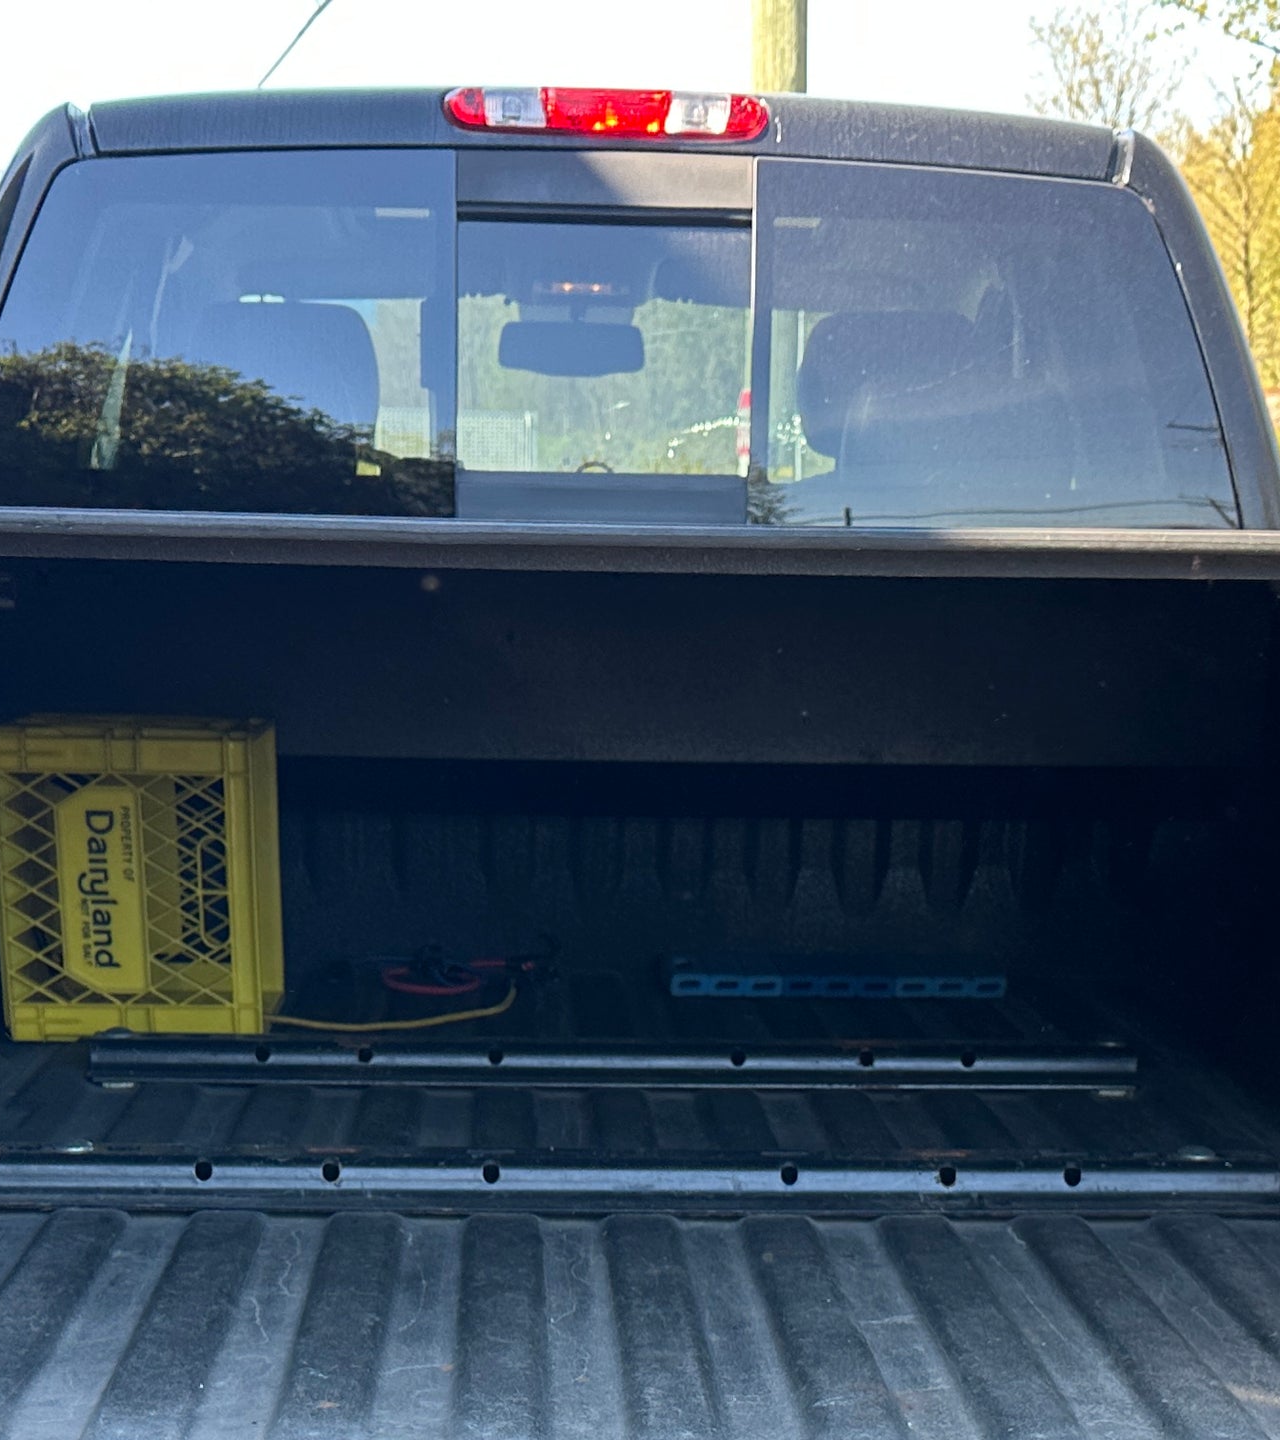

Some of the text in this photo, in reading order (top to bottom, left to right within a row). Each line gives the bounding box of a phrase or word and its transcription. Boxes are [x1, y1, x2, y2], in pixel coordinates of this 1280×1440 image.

[78, 810, 122, 968] Dairyland
[120, 806, 136, 883] PROPERTY OF
